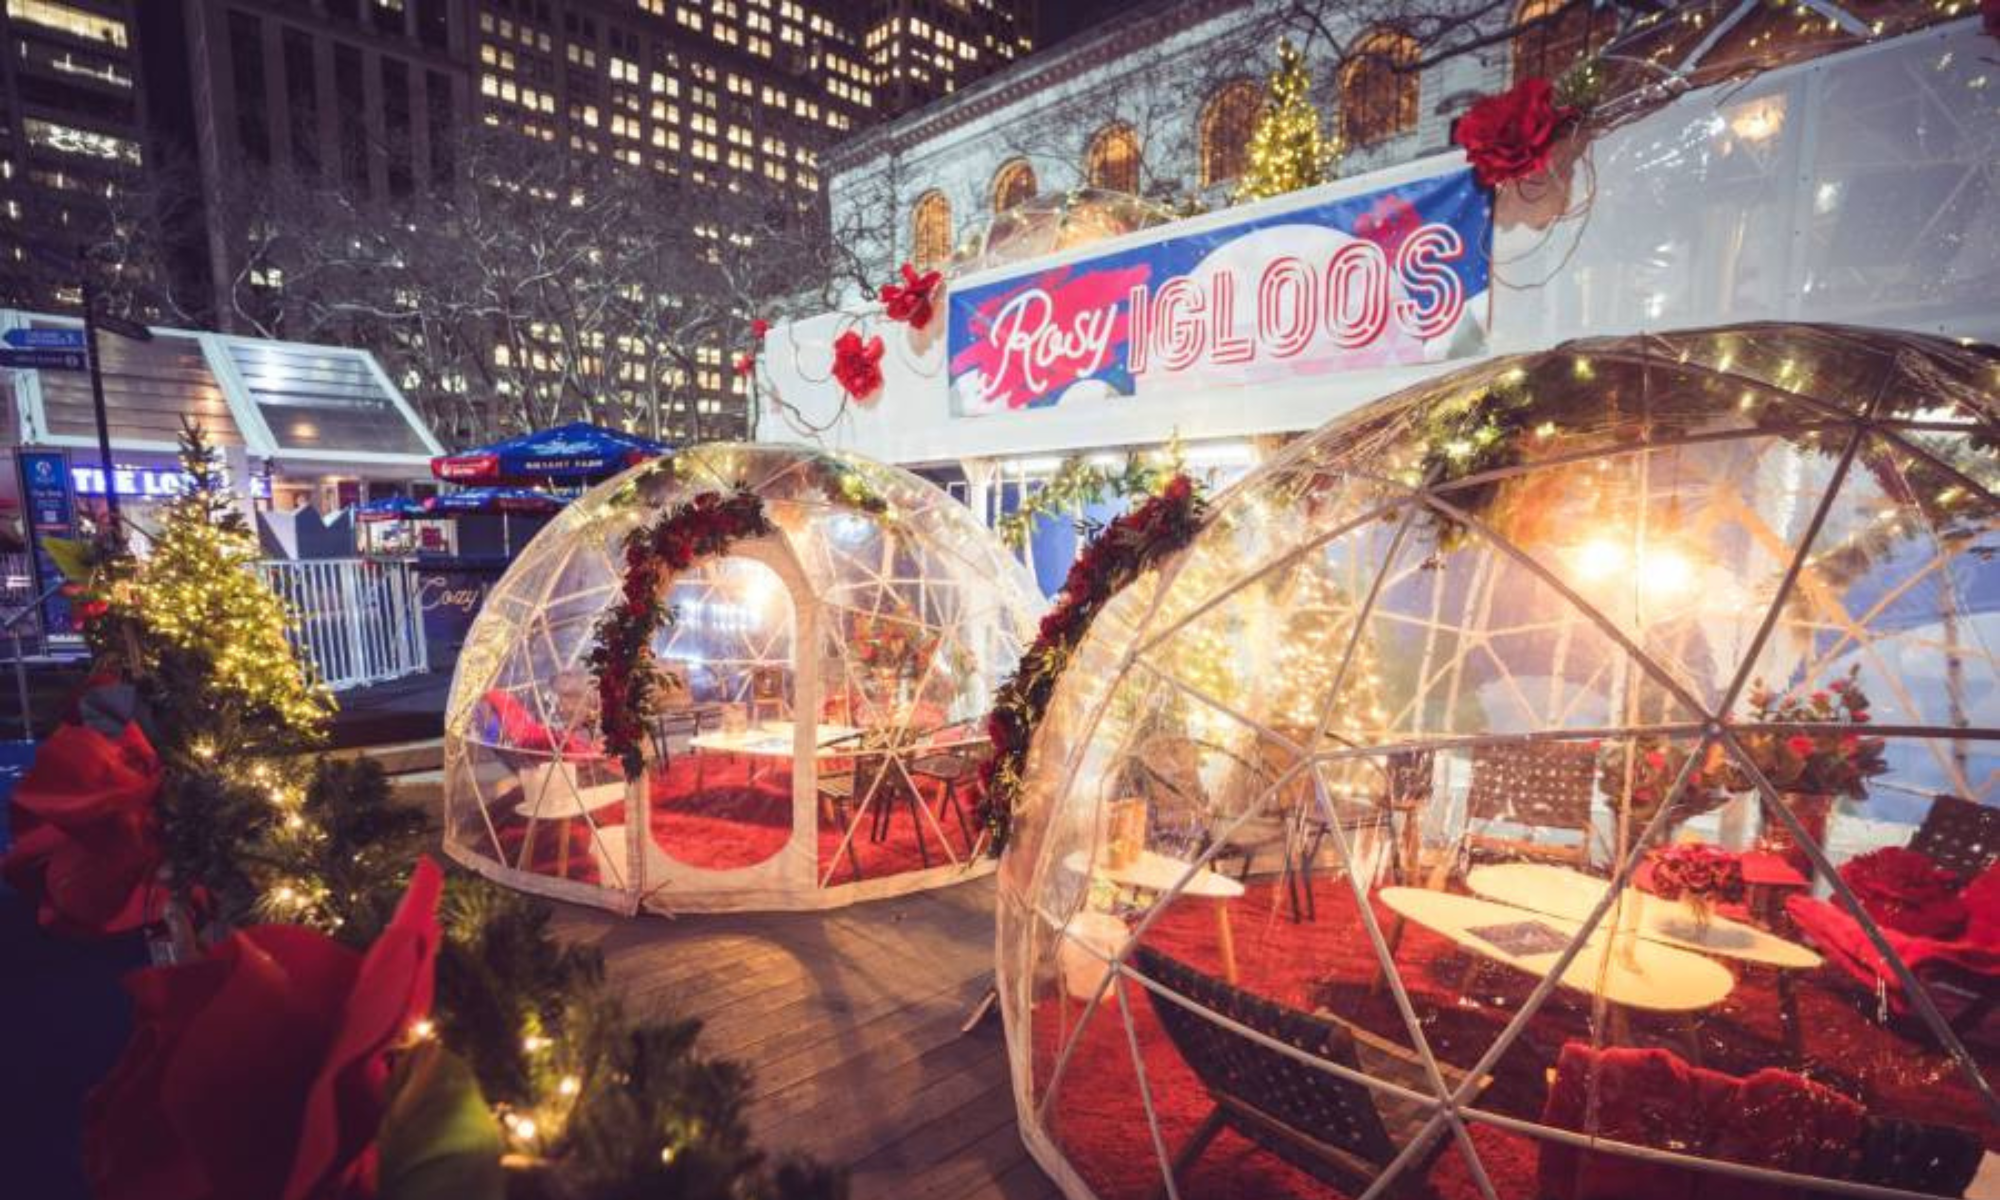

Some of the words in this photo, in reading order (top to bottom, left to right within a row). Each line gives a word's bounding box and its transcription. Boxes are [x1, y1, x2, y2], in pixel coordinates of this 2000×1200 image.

[982, 287, 1119, 393] Rosy
[1127, 223, 1465, 376] IGLOOS
[420, 577, 479, 613] Cozy
